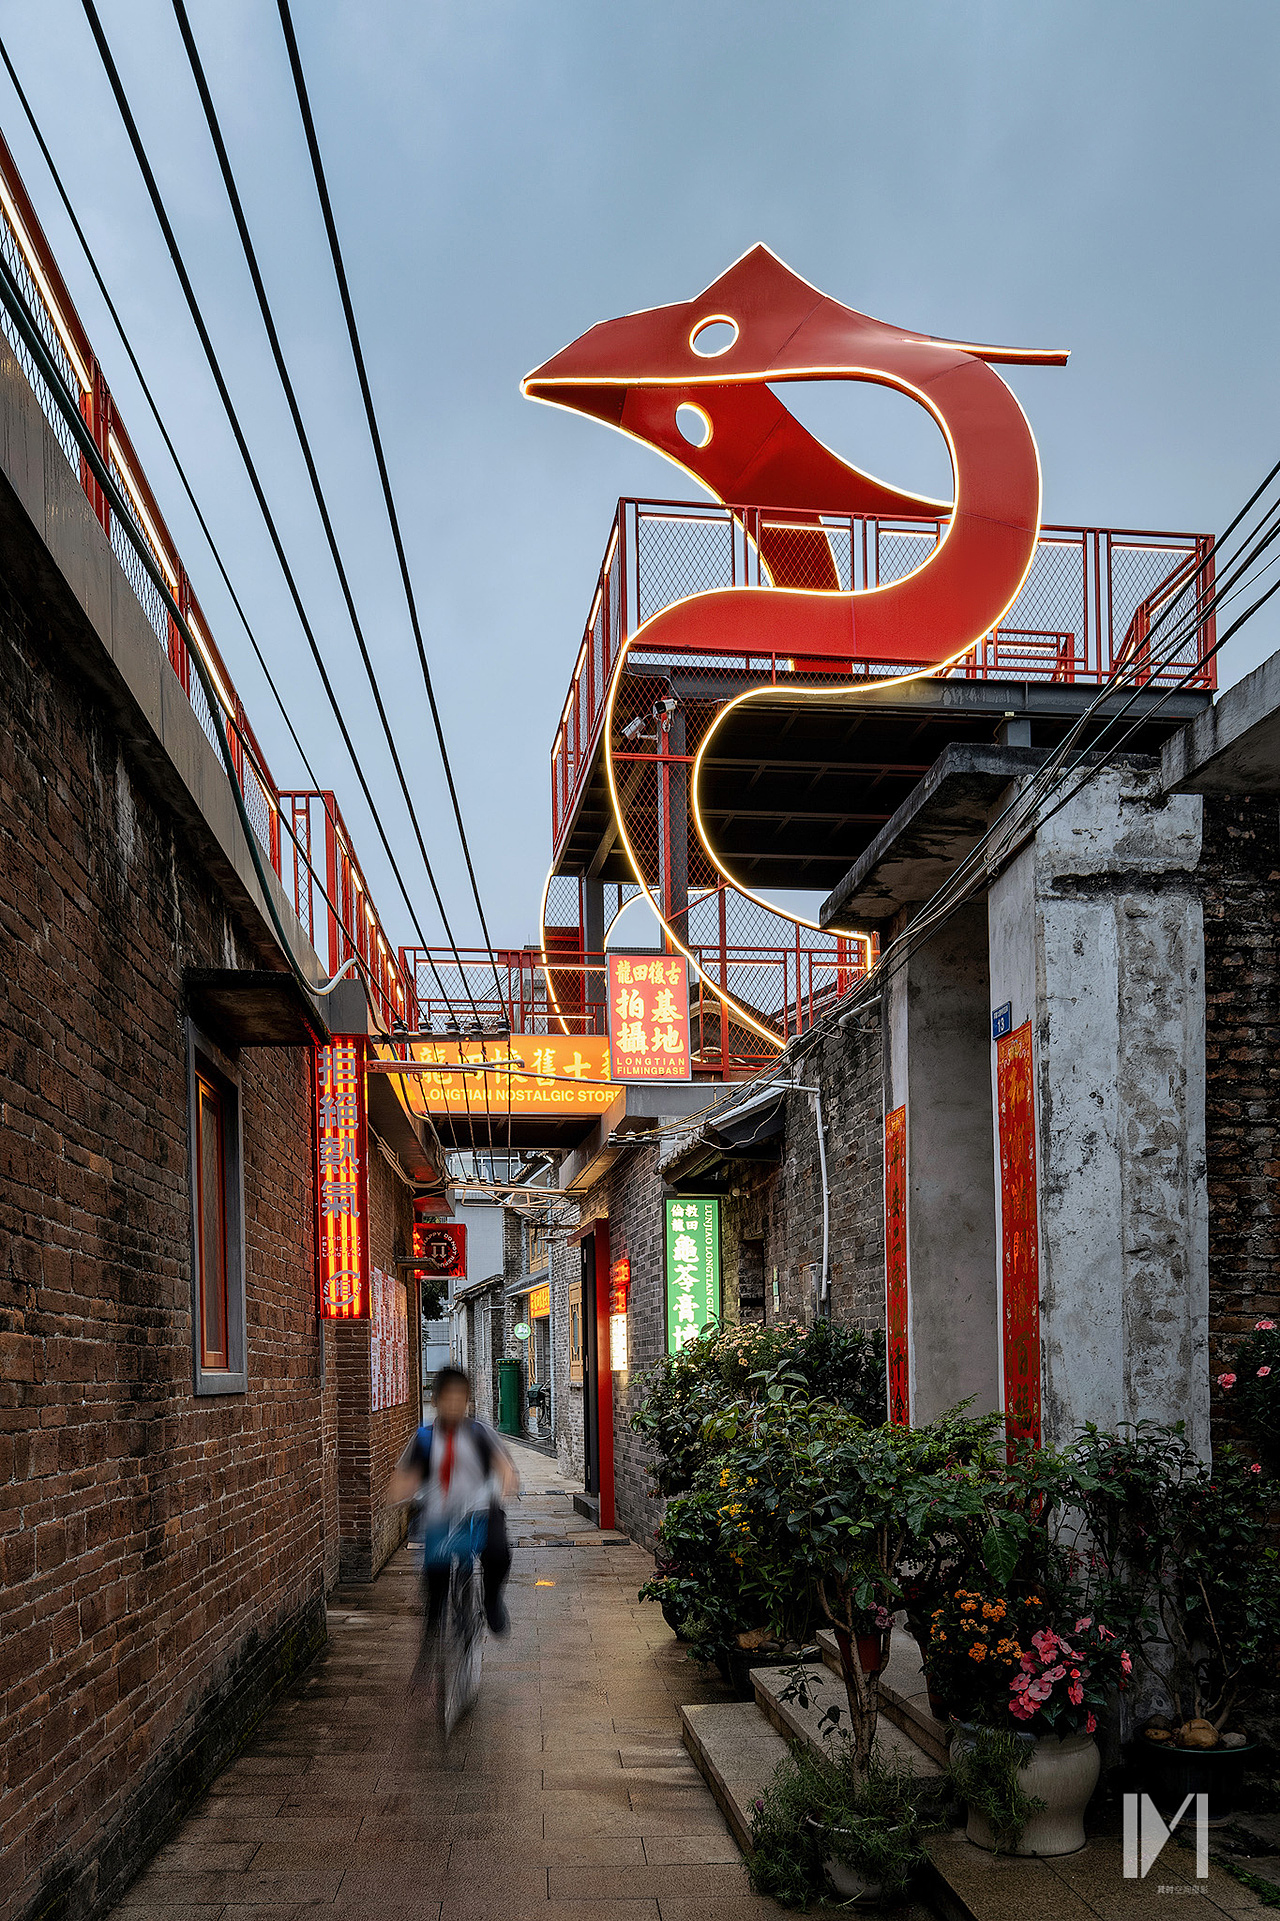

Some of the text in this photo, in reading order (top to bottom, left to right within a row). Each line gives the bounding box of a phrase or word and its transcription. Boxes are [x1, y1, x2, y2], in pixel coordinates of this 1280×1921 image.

[650, 988, 685, 1054] 基地
[616, 1057, 685, 1066] LONGTIAN
[616, 1066, 685, 1075] FILMINGBASE
[421, 1088, 492, 1101] LONGTIAN
[495, 1089, 575, 1102] NOSTALGIC
[703, 1204, 713, 1245] LUNJIAO
[705, 1246, 714, 1296] LONGTIAN
